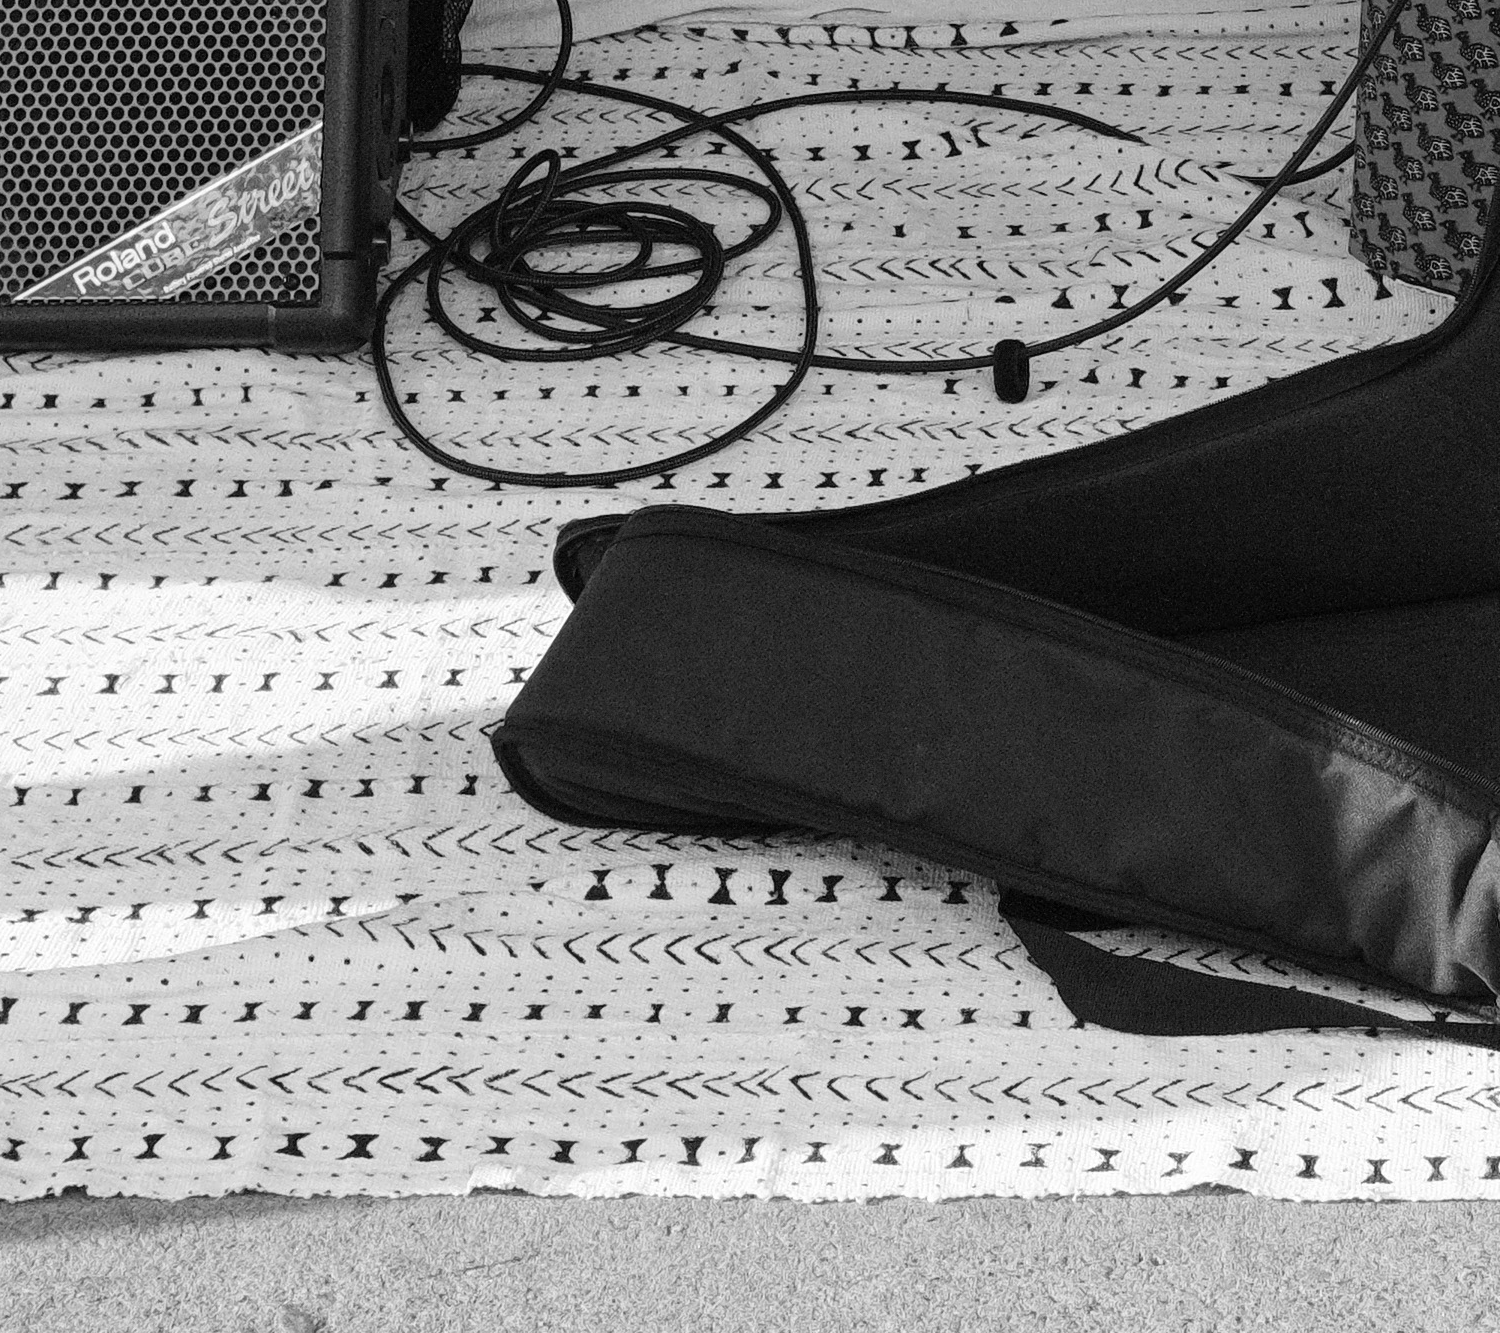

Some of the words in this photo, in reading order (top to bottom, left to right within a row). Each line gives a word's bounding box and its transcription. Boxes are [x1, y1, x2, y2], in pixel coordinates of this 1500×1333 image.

[71, 221, 177, 294] Roland
[122, 237, 206, 291] CUBE
[207, 158, 315, 247] Street
